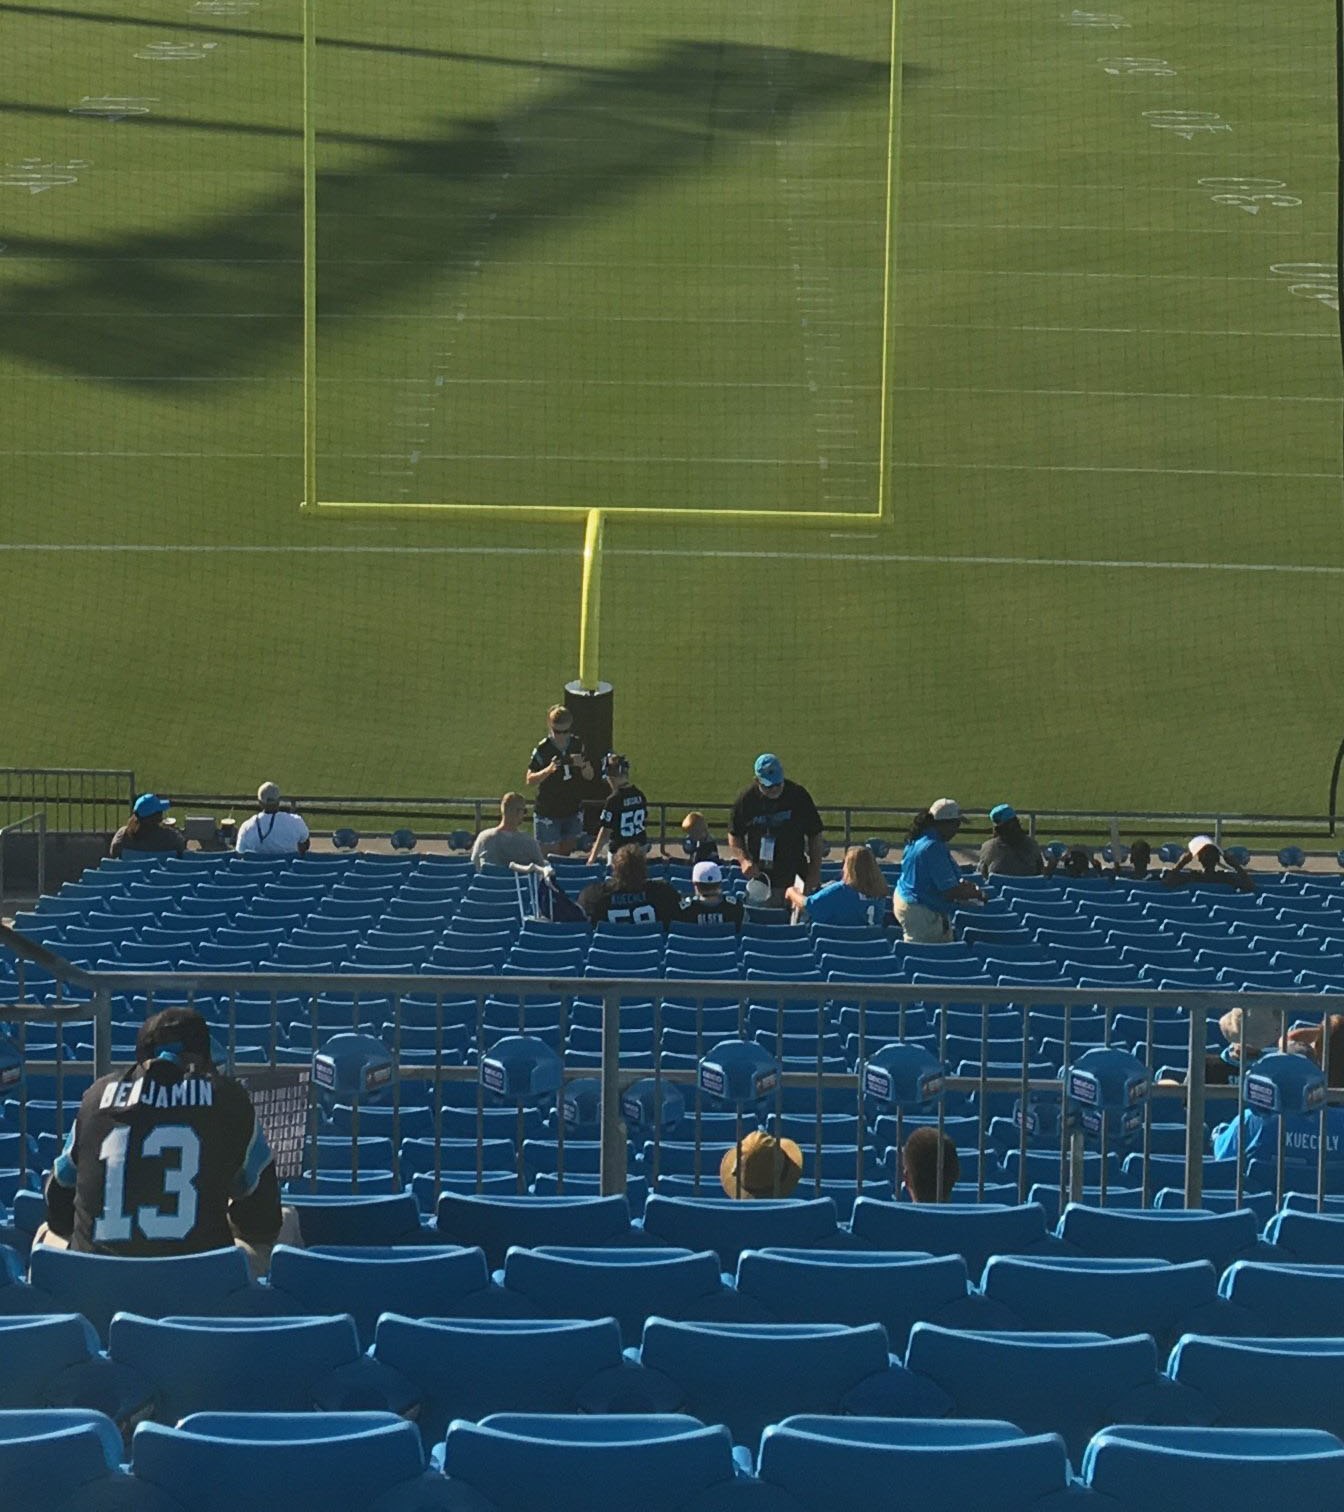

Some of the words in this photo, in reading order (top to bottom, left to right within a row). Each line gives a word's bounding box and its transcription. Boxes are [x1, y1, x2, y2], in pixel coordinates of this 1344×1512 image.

[620, 808, 646, 837] 59
[99, 1076, 213, 1110] BENJAMIN
[1284, 1131, 1340, 1152] KUECLY
[92, 1123, 202, 1241] 13
